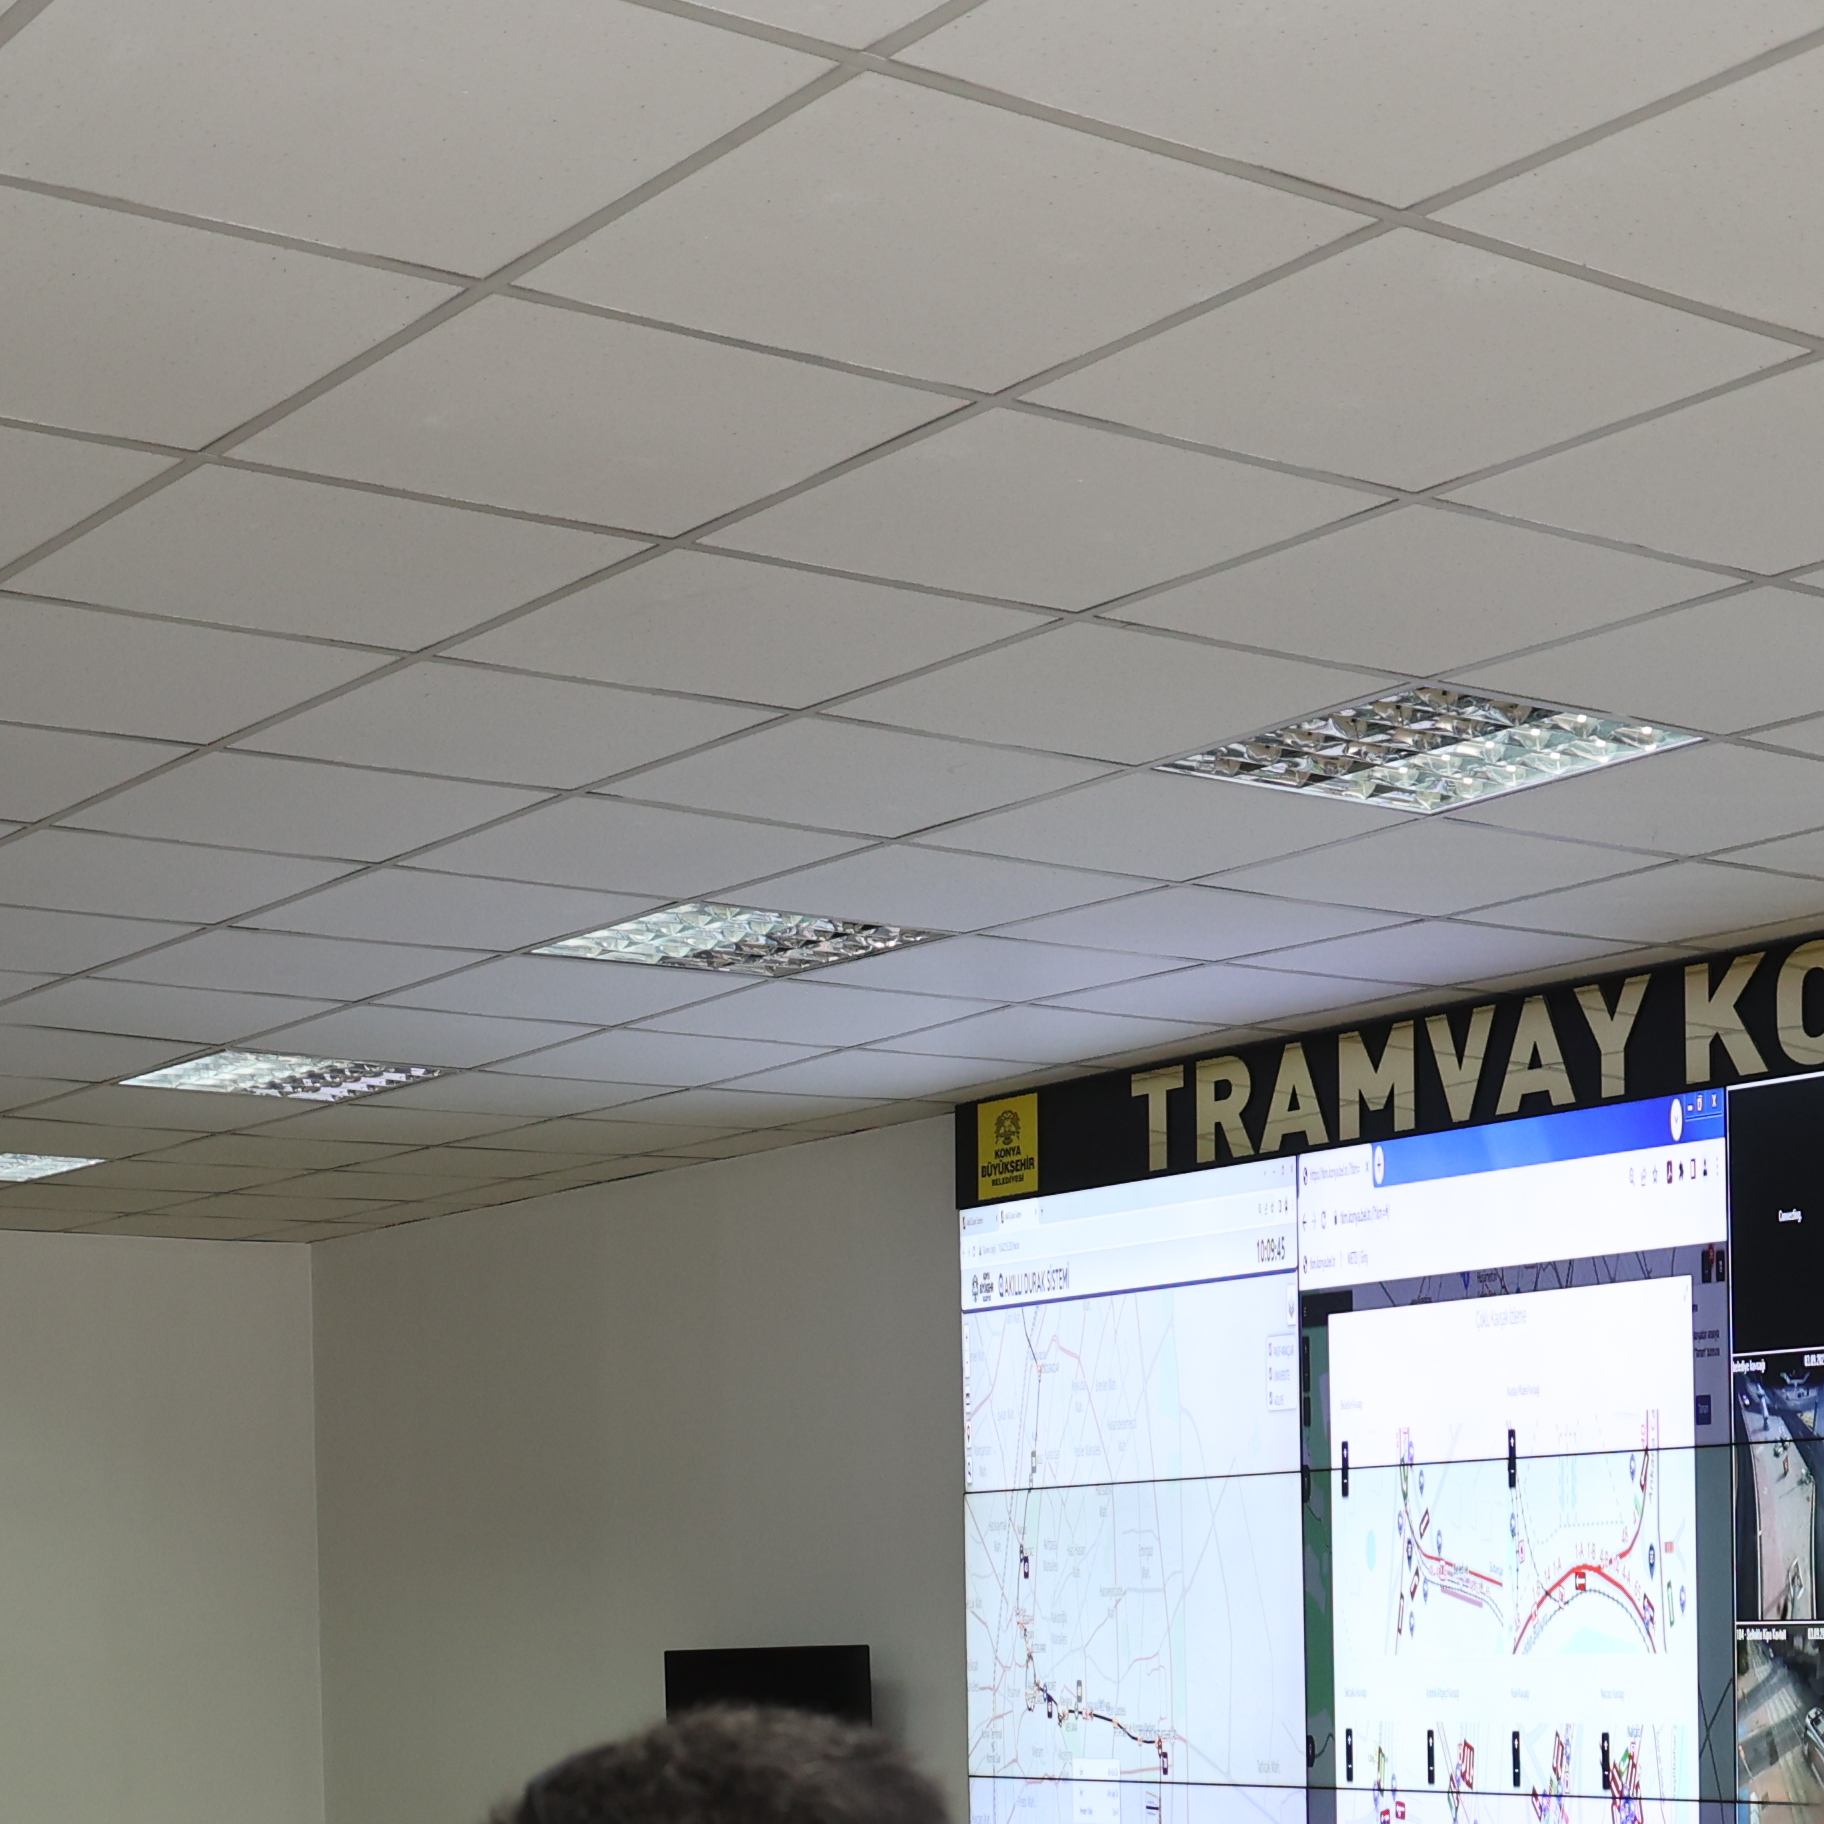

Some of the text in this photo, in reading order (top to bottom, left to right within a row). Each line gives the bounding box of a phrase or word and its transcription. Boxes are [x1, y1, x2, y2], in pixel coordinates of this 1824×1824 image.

[1131, 974, 1652, 1172] TRAMVAY
[994, 1145, 1021, 1160] KONYA
[981, 1155, 1035, 1178] BÜYÜKŞEHİR
[1257, 1236, 1286, 1263] 10:09:45
[1024, 1270, 1045, 1295] DURAK
